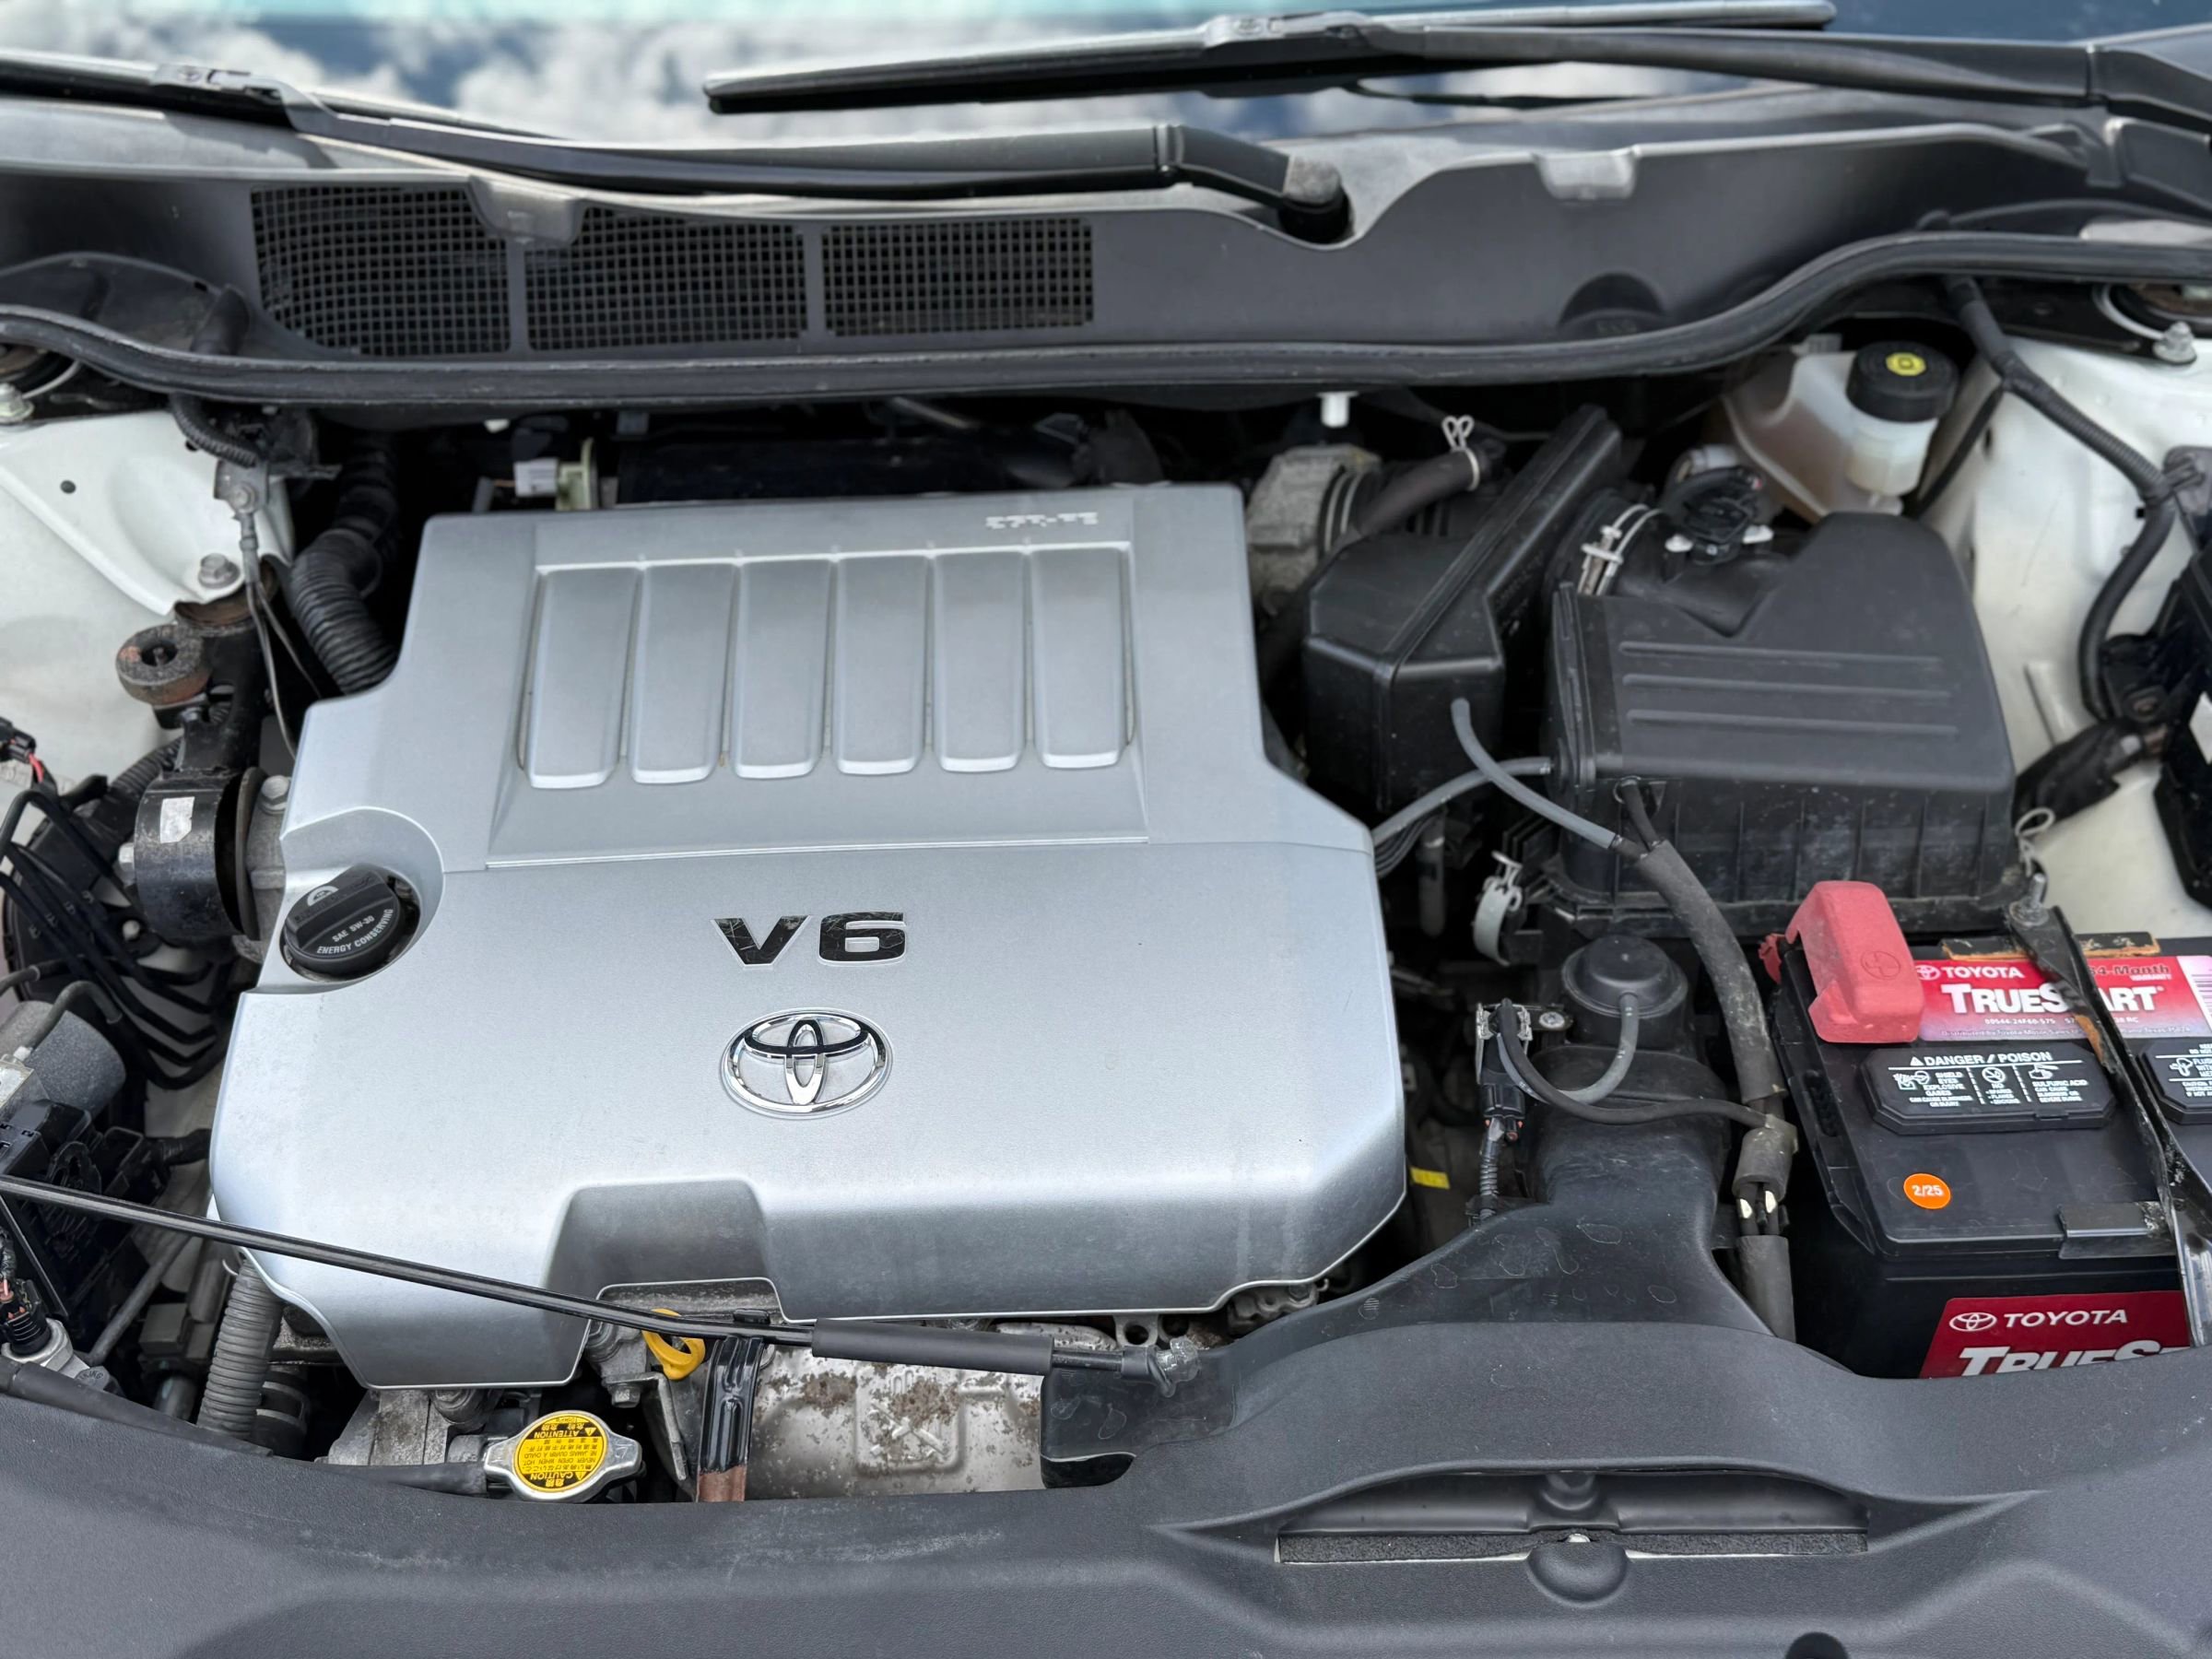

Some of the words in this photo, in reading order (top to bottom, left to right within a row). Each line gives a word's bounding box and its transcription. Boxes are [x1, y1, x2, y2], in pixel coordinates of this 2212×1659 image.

[316, 943, 352, 954] ENERGY
[354, 909, 394, 947] CONSERVING
[332, 930, 348, 942] SAE
[349, 915, 375, 932] 5W-30
[712, 911, 906, 966] V6
[1941, 966, 2026, 979] TOYOTA
[1940, 982, 2158, 1014] TRUESRT
[1924, 1054, 1985, 1065] DANGER
[1987, 1053, 1995, 1064] /
[1997, 1052, 2053, 1063] POISON
[1912, 1184, 1944, 1196] 2/25
[2004, 1309, 2128, 1328] TOYOTA
[530, 1471, 573, 1480] CAUTION
